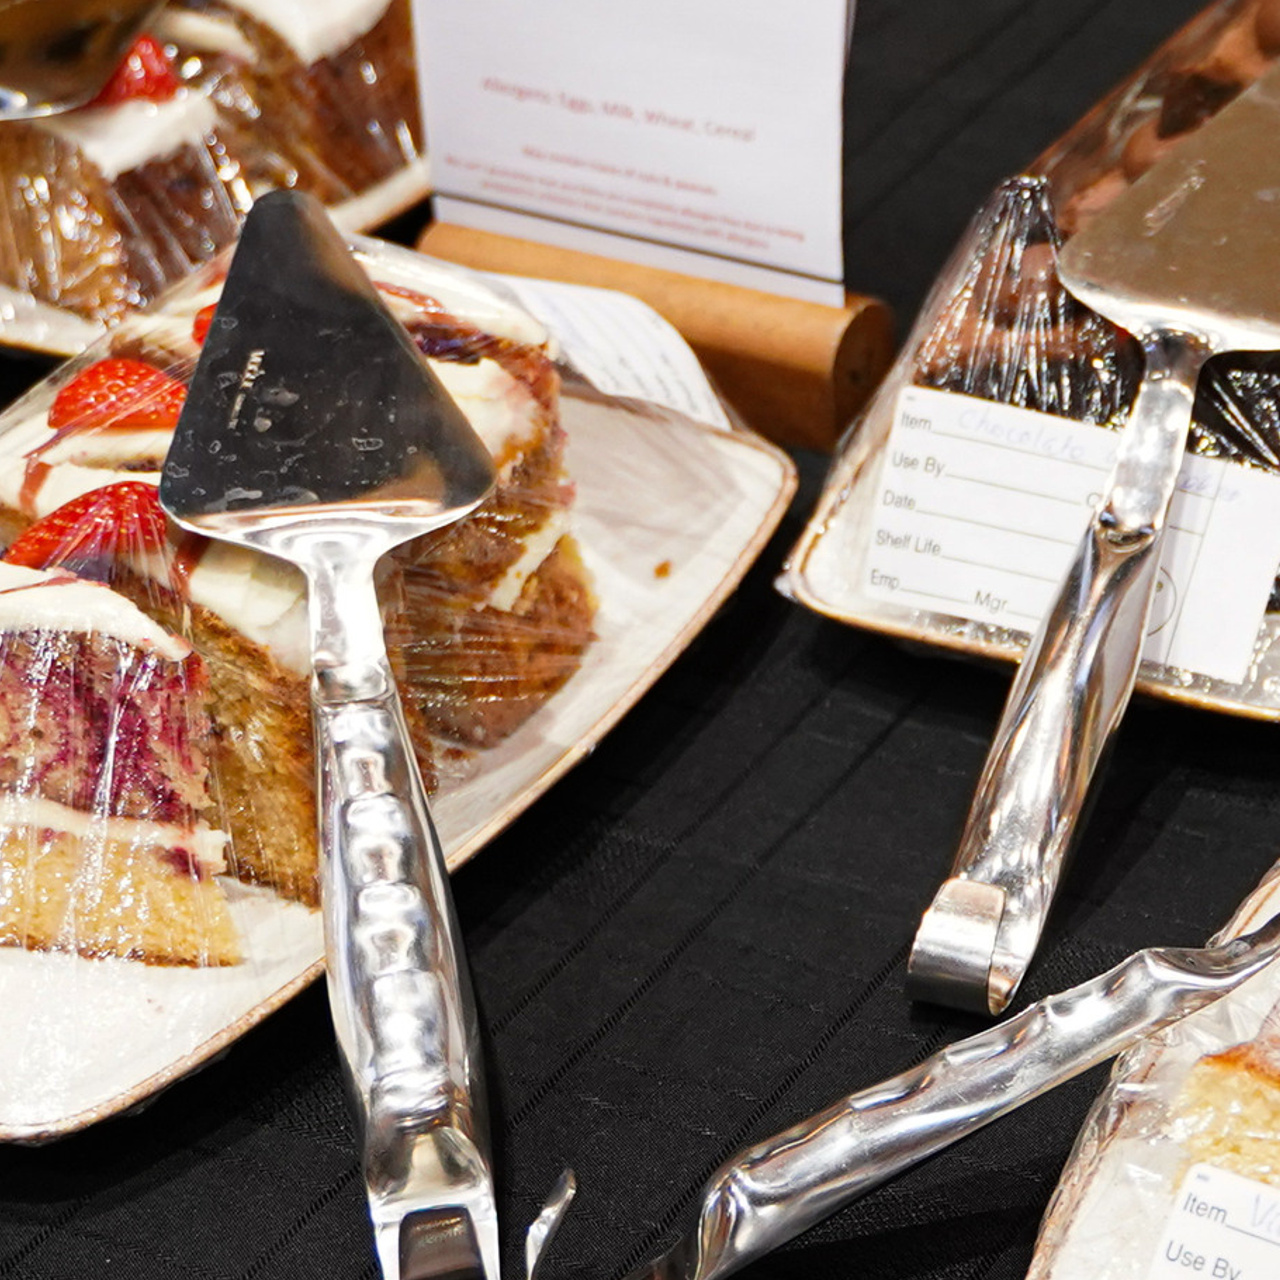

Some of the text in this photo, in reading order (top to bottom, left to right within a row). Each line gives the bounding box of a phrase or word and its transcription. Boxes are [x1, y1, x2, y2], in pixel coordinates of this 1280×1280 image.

[900, 412, 931, 431] Item
[892, 451, 946, 479] Use By
[882, 490, 916, 511] Date
[876, 529, 941, 558] Shelf Life
[870, 570, 1008, 612] Emp Mgr
[1181, 1192, 1228, 1227] Item
[1166, 1241, 1205, 1272] Use
